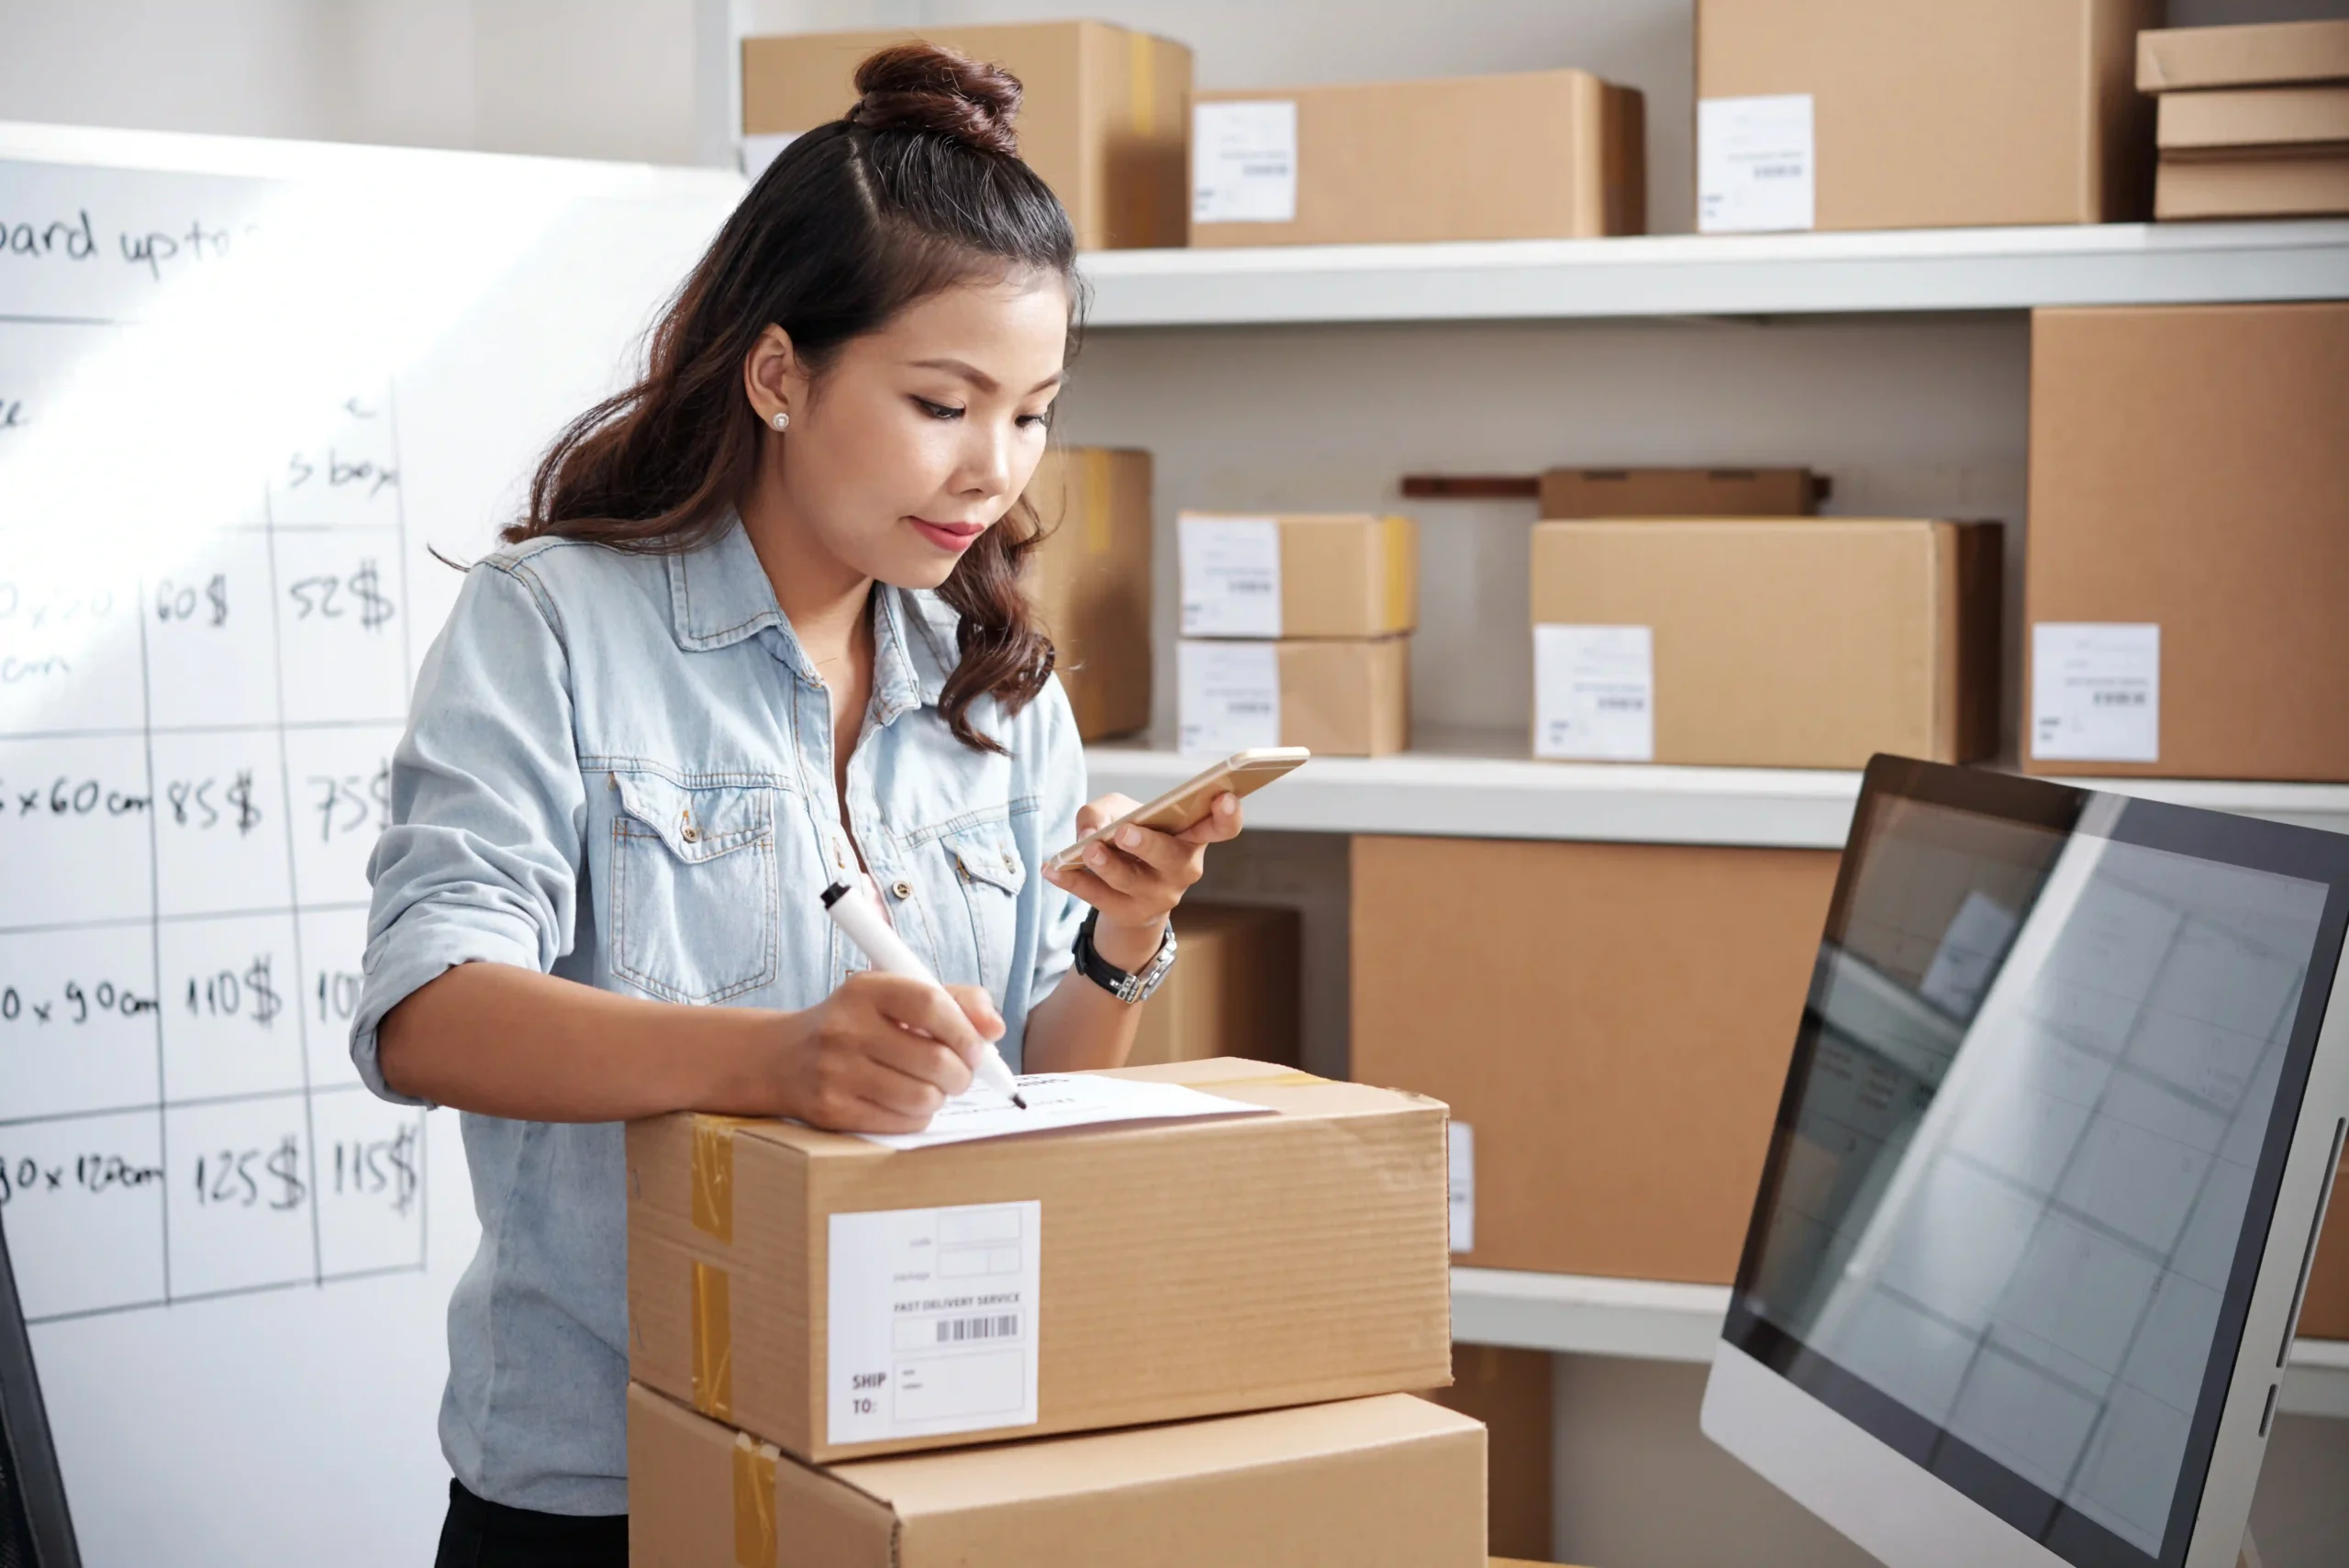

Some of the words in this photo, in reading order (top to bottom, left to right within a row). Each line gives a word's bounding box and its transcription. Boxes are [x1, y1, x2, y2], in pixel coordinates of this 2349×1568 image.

[289, 559, 395, 633] 52$
[167, 769, 262, 836] 85$
[188, 953, 281, 1028] 110$
[195, 1137, 305, 1208] 125$
[335, 1123, 417, 1216] 115$
[895, 1301, 920, 1312] FAST
[923, 1296, 973, 1310] DELIVERY
[977, 1291, 1019, 1306] SERVICE
[852, 1372, 886, 1390] SHIP
[853, 1398, 877, 1415] TO:
